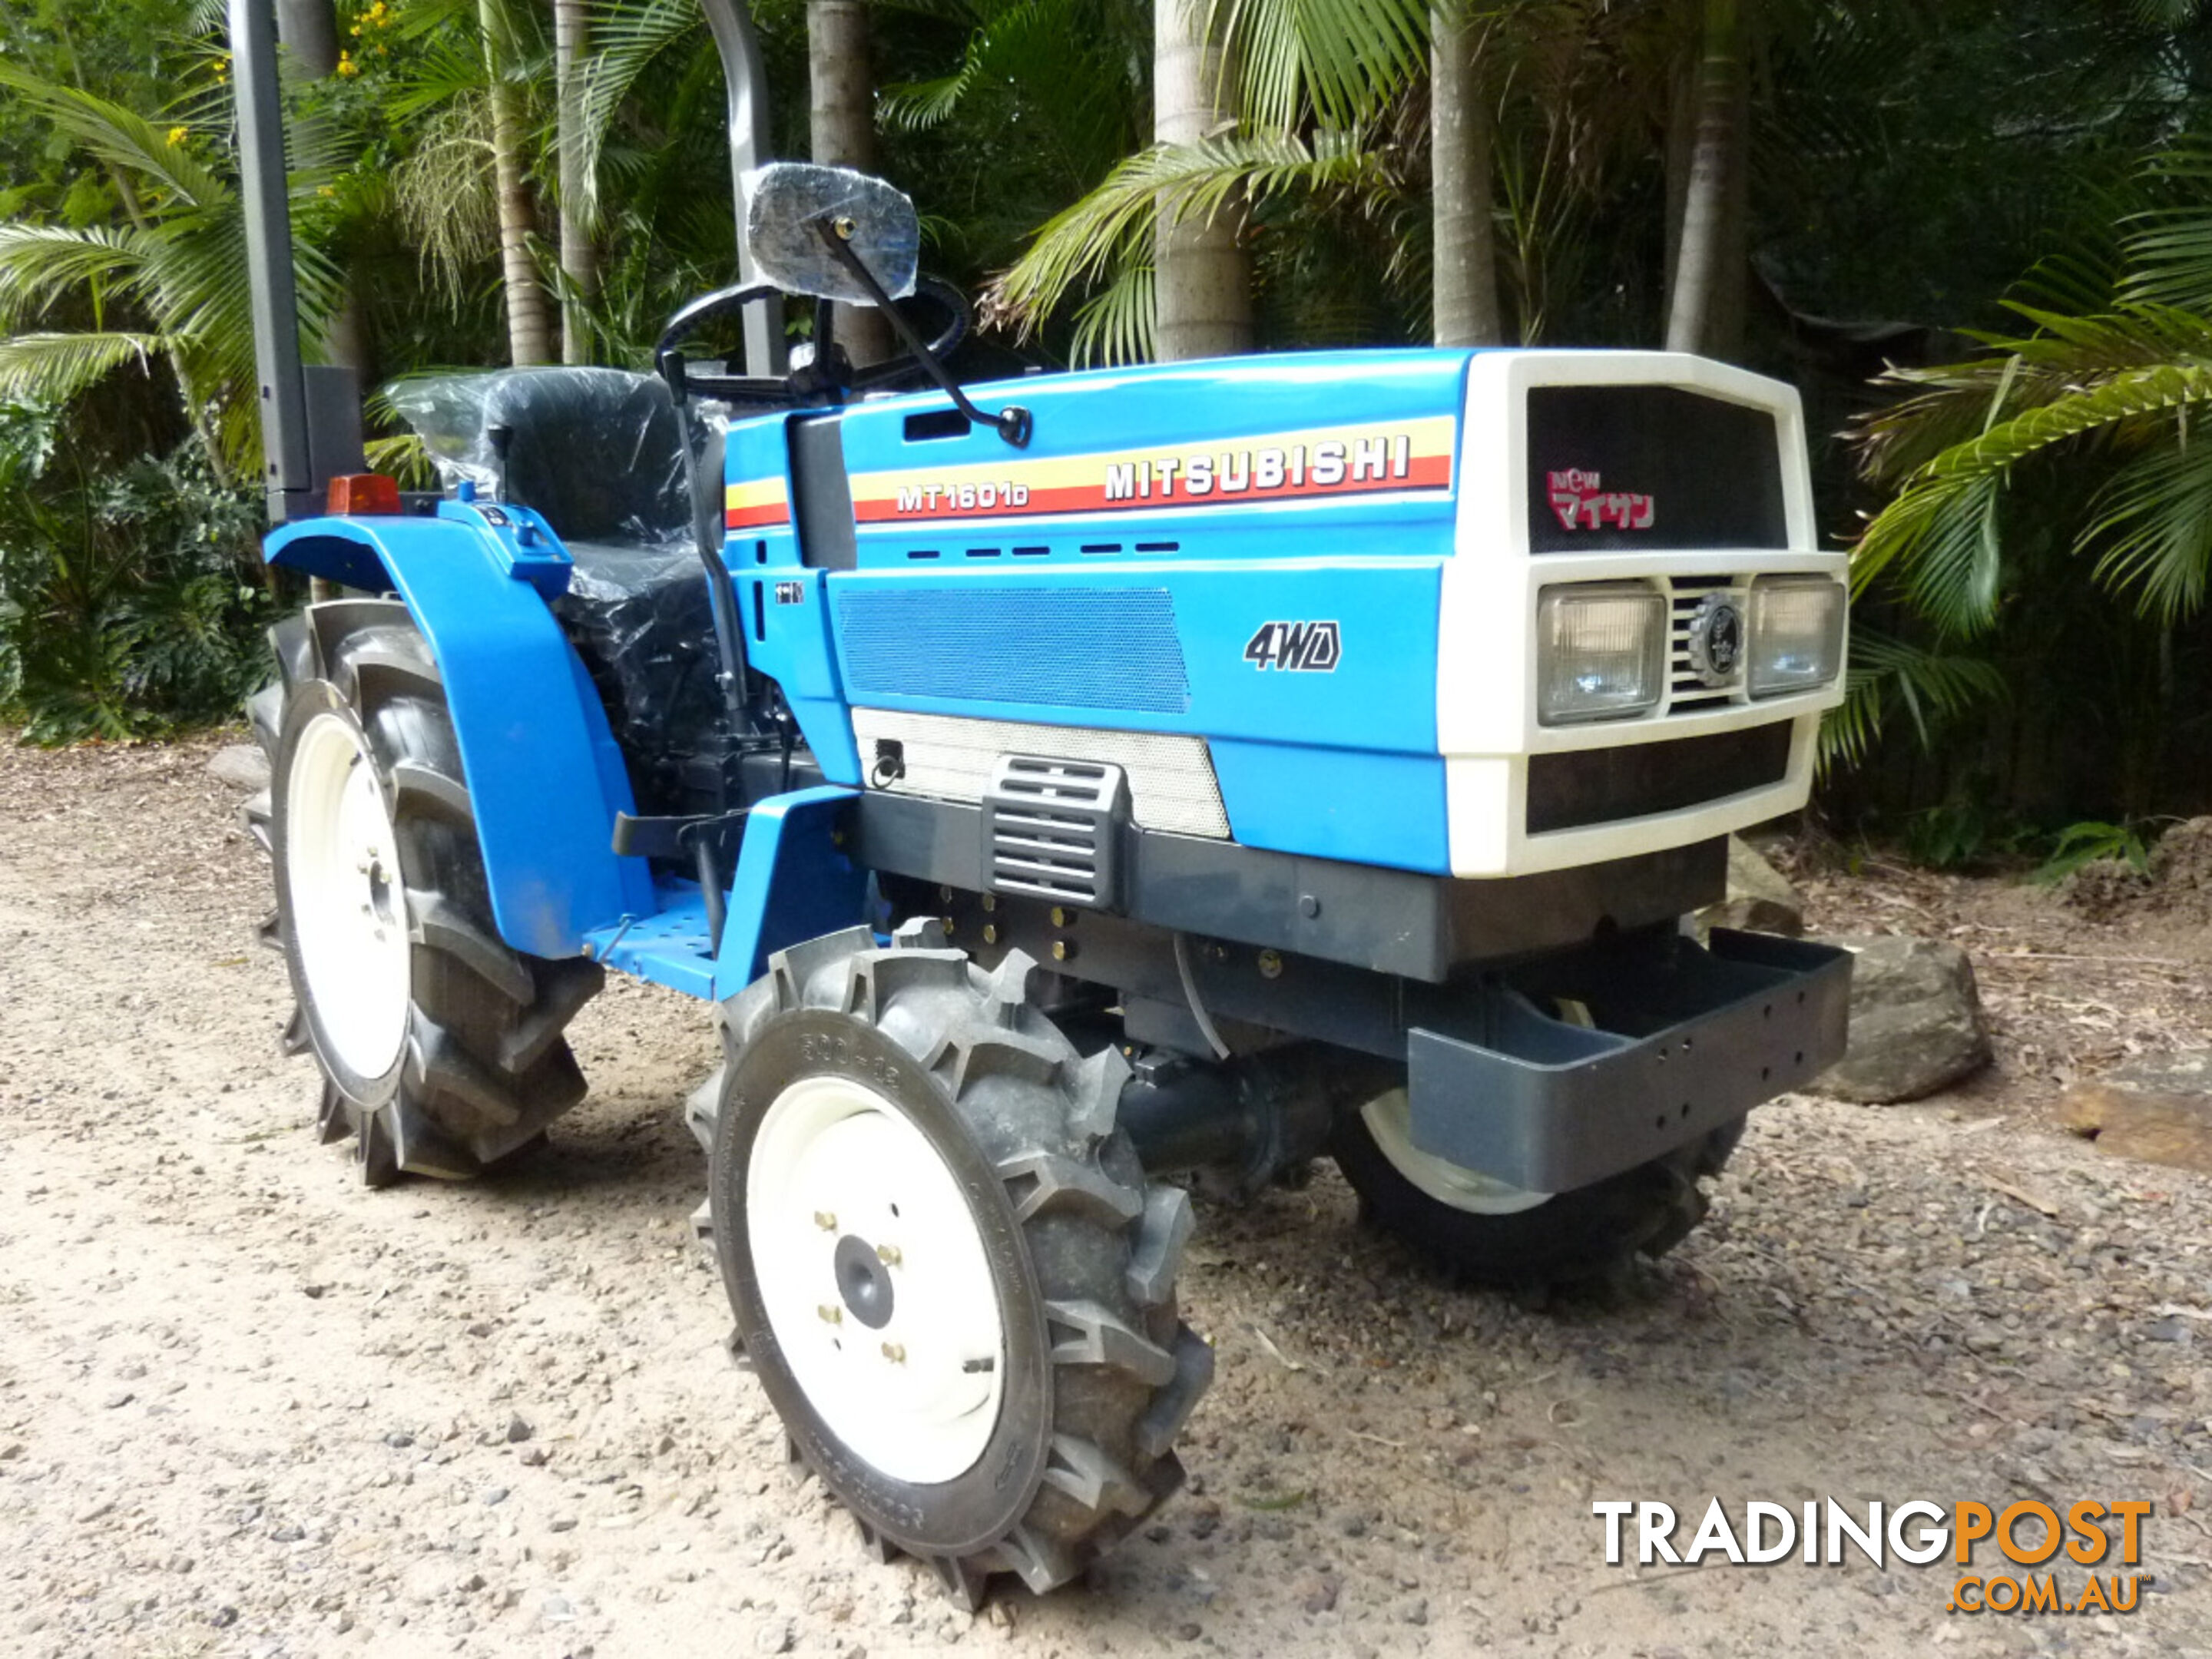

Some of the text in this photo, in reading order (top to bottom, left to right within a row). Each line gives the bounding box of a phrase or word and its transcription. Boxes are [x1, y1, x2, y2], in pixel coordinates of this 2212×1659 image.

[1104, 435, 1409, 501] MITSUBISHI
[897, 481, 1029, 513] MT1601D
[1243, 621, 1342, 673] 4WD
